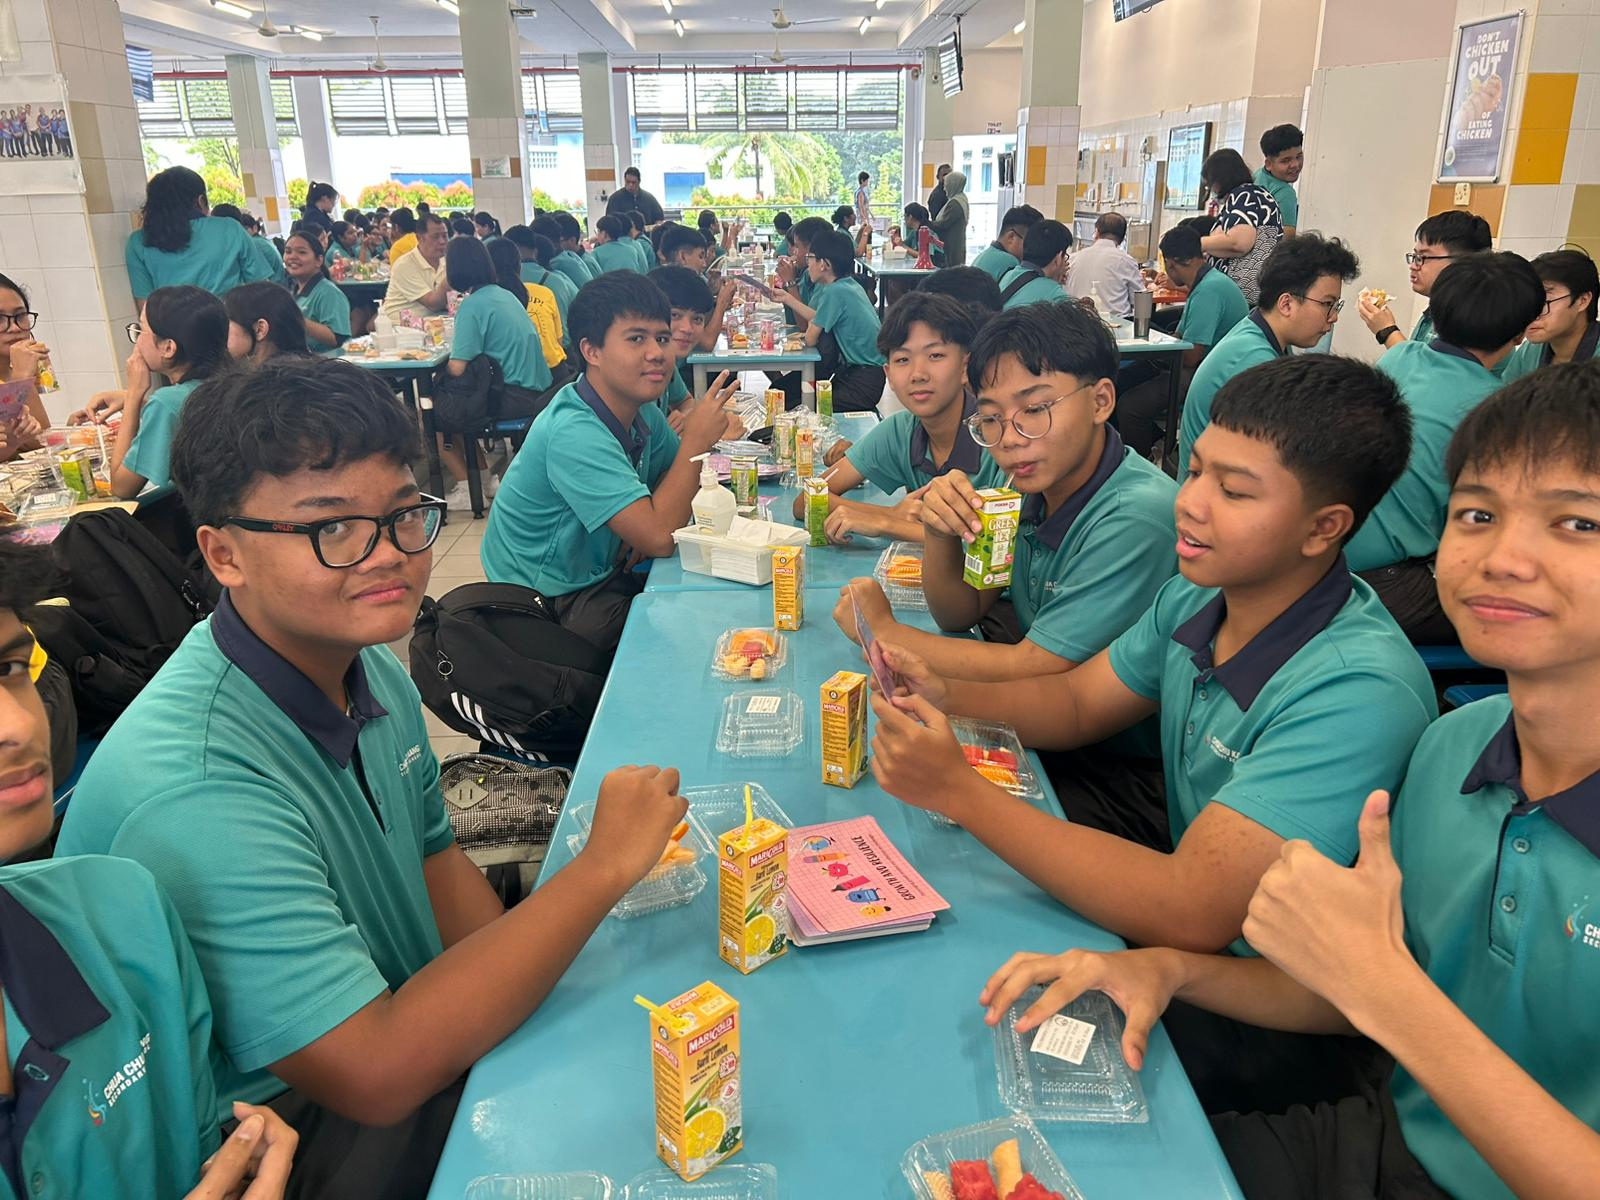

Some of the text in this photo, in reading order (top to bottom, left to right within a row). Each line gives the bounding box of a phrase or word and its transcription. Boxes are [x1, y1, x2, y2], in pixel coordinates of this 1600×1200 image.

[1477, 31, 1500, 44] DON'T
[1465, 39, 1509, 58] CHICKEN
[1468, 55, 1501, 80] OUT
[1468, 120, 1492, 129] EATING
[1481, 111, 1492, 120] OF
[1456, 128, 1492, 140] CHICKEN
[750, 841, 784, 867] MARIGOLD
[886, 877, 916, 901] GROWTH
[688, 1016, 734, 1054] MARIGOLD
[103, 1071, 125, 1100] CHUA
